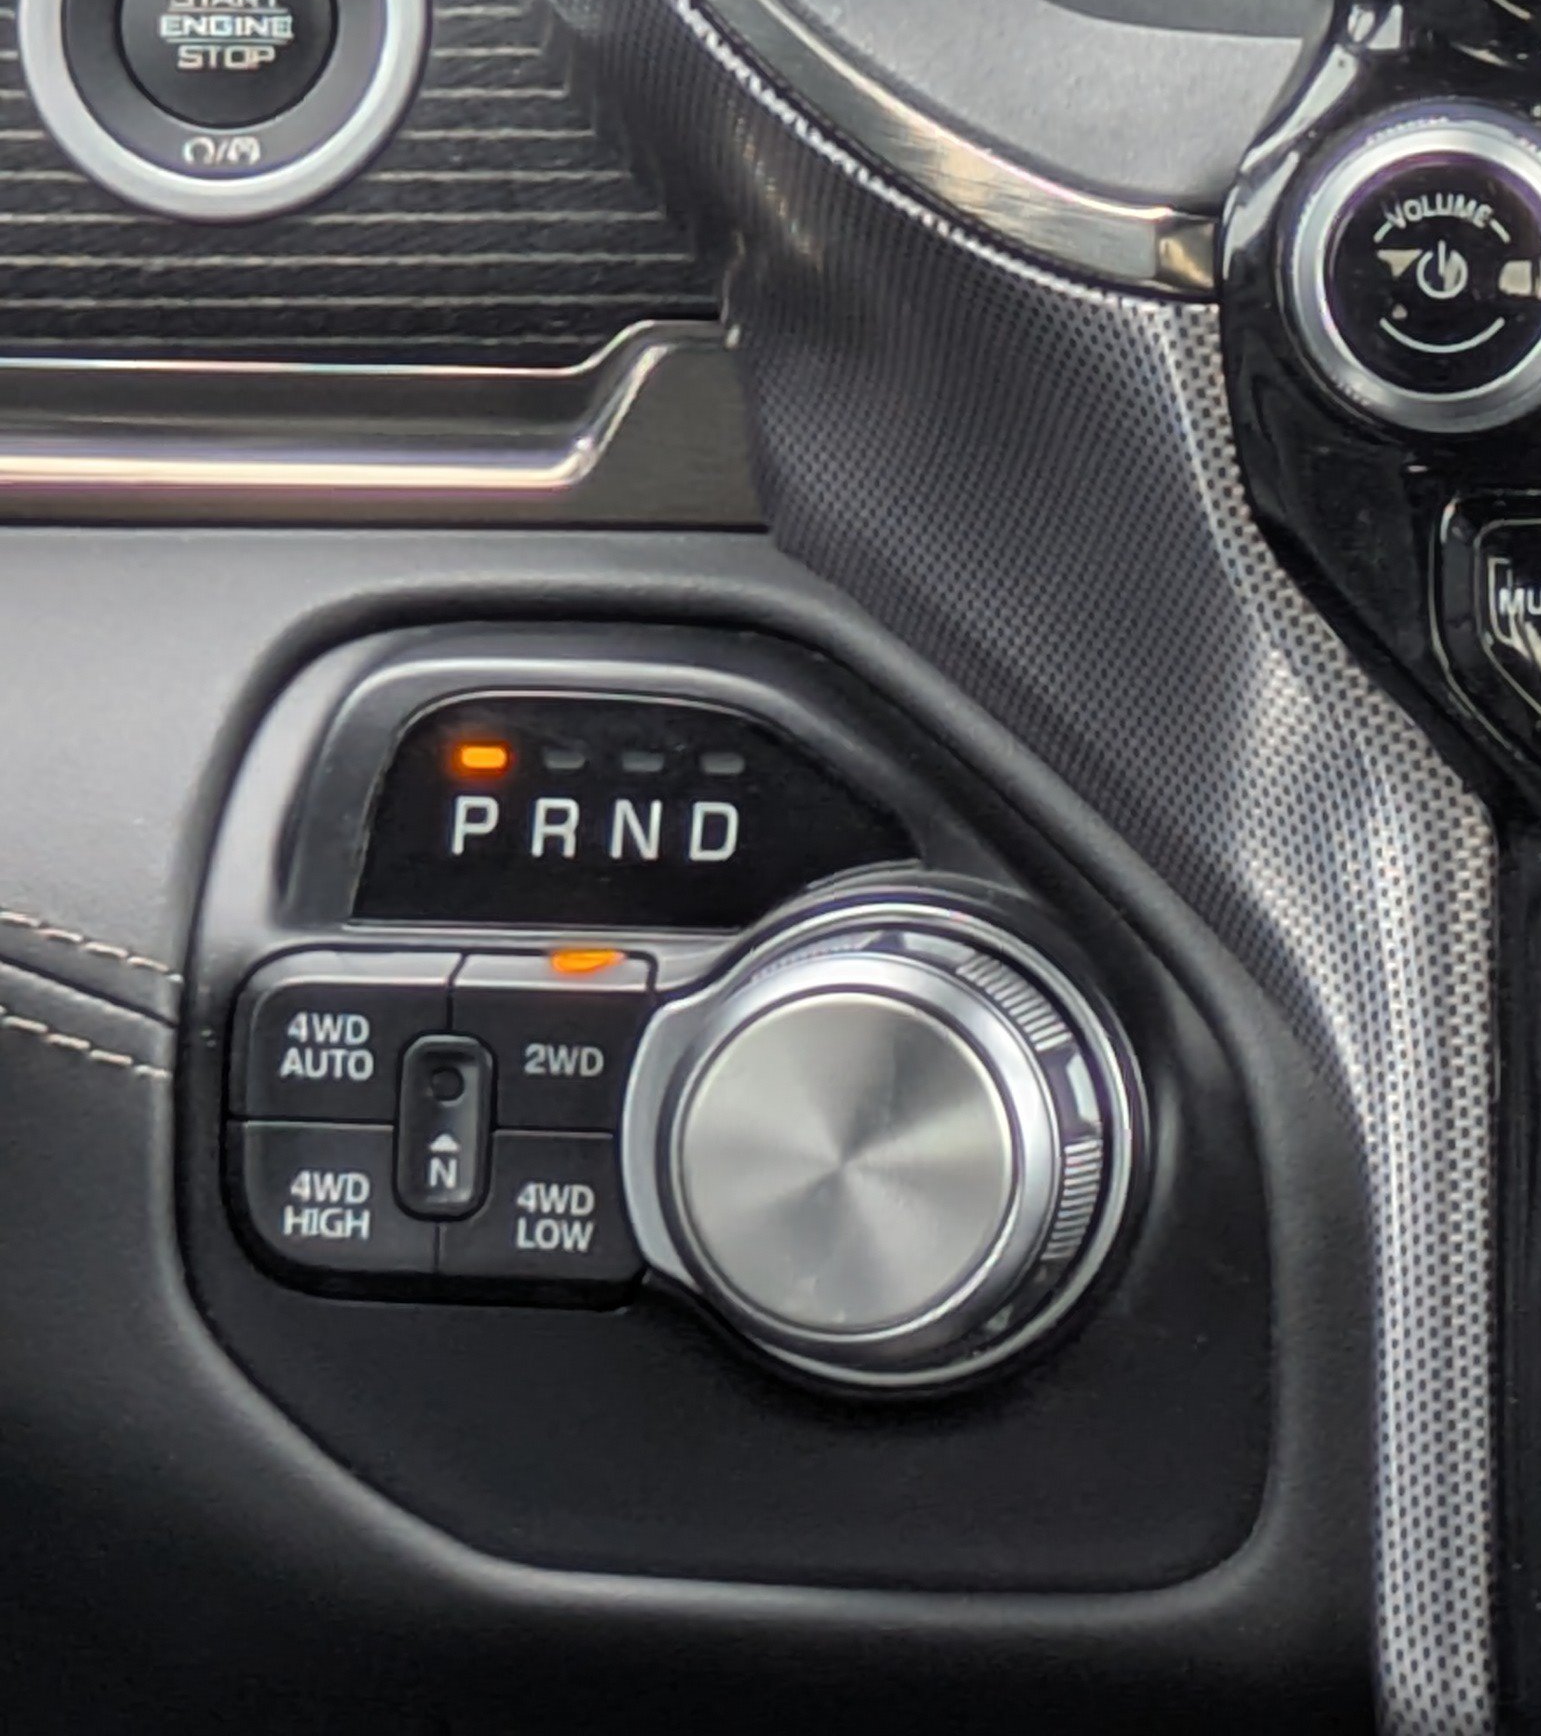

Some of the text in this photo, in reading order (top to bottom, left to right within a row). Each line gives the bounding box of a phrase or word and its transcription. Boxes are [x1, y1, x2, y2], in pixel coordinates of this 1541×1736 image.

[160, 14, 294, 39] ENGINE
[177, 45, 275, 70] STOP
[1381, 192, 1494, 230] VOLUME
[451, 796, 739, 862] P R N D
[287, 1013, 370, 1045] 4WD
[280, 1048, 374, 1081] AUTO
[524, 1045, 604, 1077] 2WD
[290, 1172, 370, 1204] 4WD
[429, 1157, 458, 1188] N
[516, 1184, 595, 1217] 4WD
[283, 1206, 370, 1239] HIGH
[516, 1217, 594, 1252] LOW
